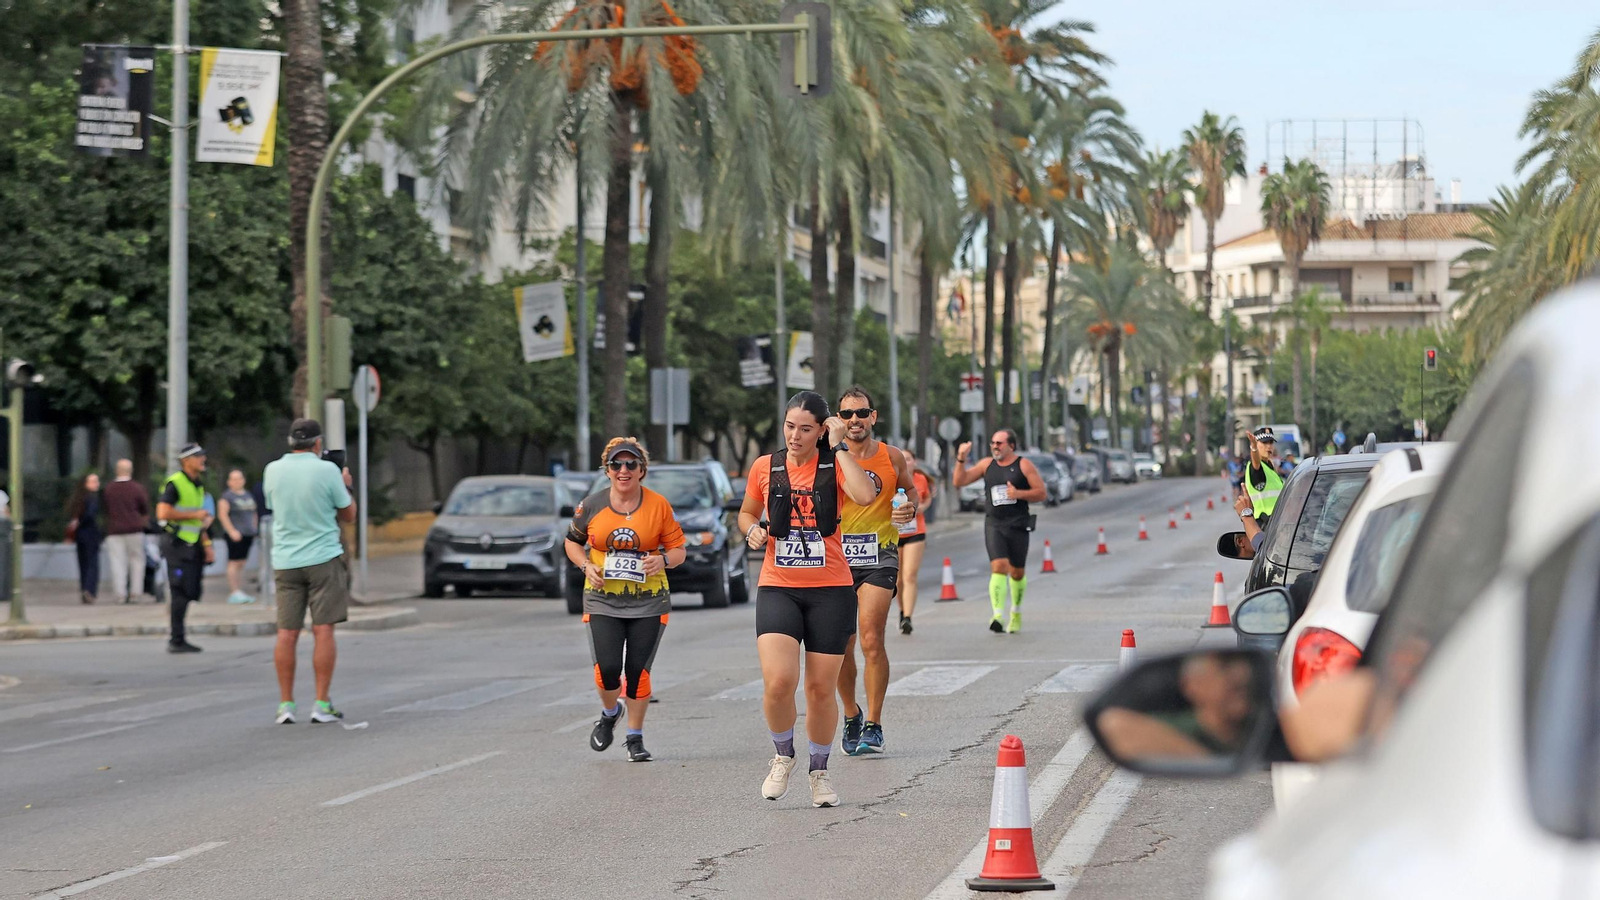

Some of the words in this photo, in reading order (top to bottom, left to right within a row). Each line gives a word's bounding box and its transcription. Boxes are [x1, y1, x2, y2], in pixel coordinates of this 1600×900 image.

[613, 528, 634, 536] BEER
[845, 545, 867, 555] 634
[615, 558, 637, 570] 628
